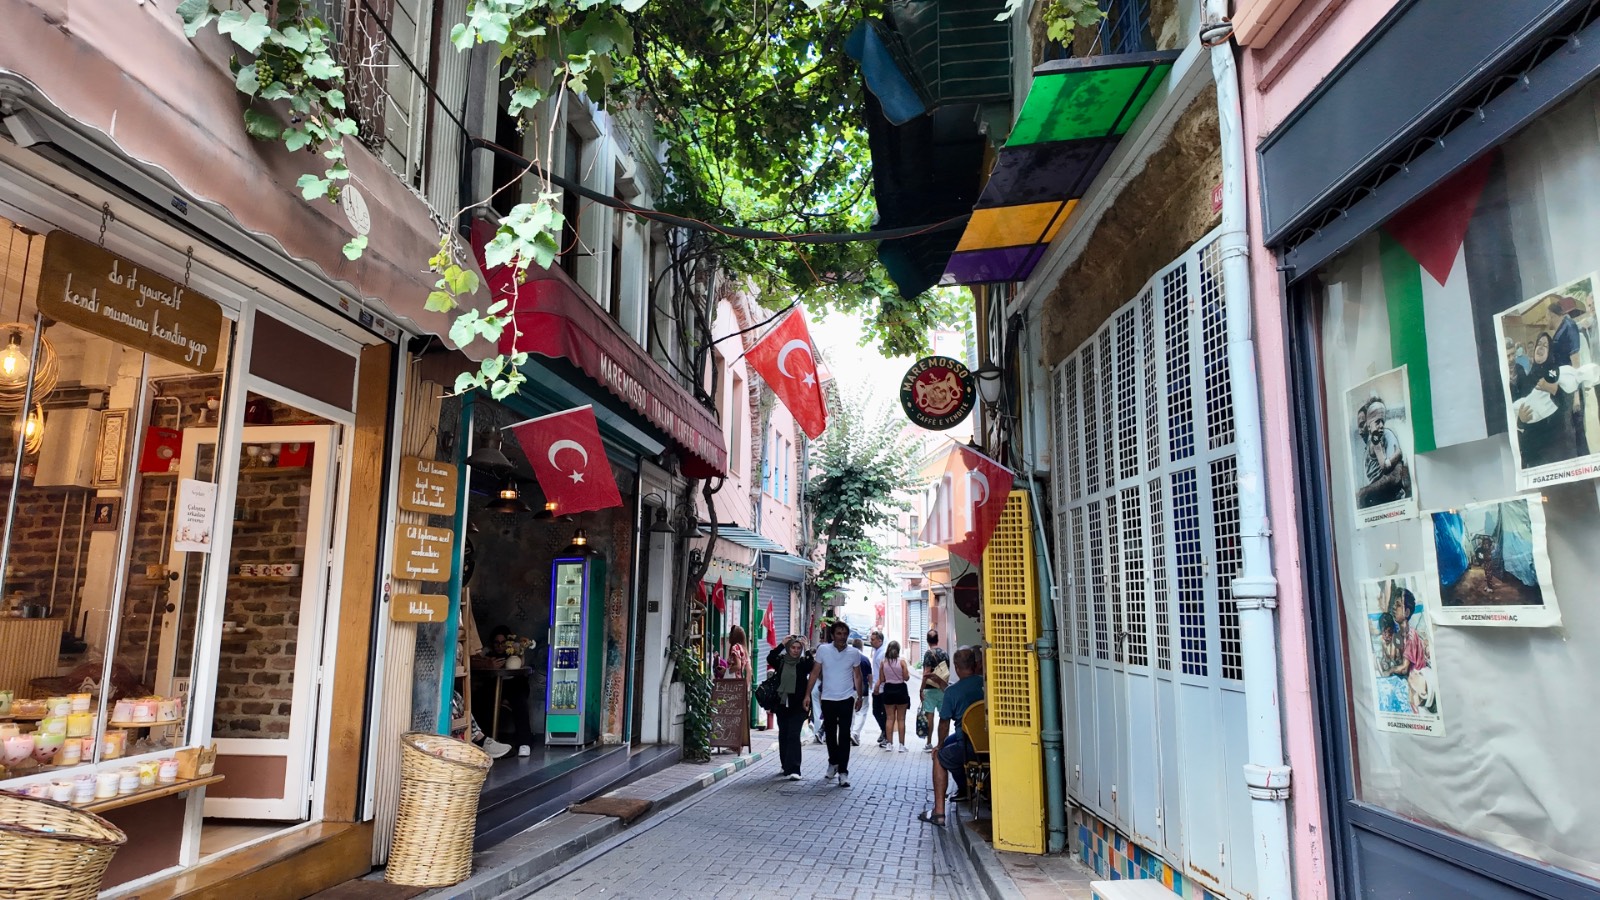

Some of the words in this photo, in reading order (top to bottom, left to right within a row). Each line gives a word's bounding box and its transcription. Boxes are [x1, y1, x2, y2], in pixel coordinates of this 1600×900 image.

[108, 259, 123, 284] do
[126, 267, 138, 291] it
[135, 284, 184, 310] yourself
[62, 272, 100, 313] kendi
[102, 304, 149, 331] mumunu
[151, 309, 187, 347] kendin
[184, 339, 208, 366] yap
[651, 396, 674, 430] ITALIAN
[944, 402, 969, 424] VENDITE
